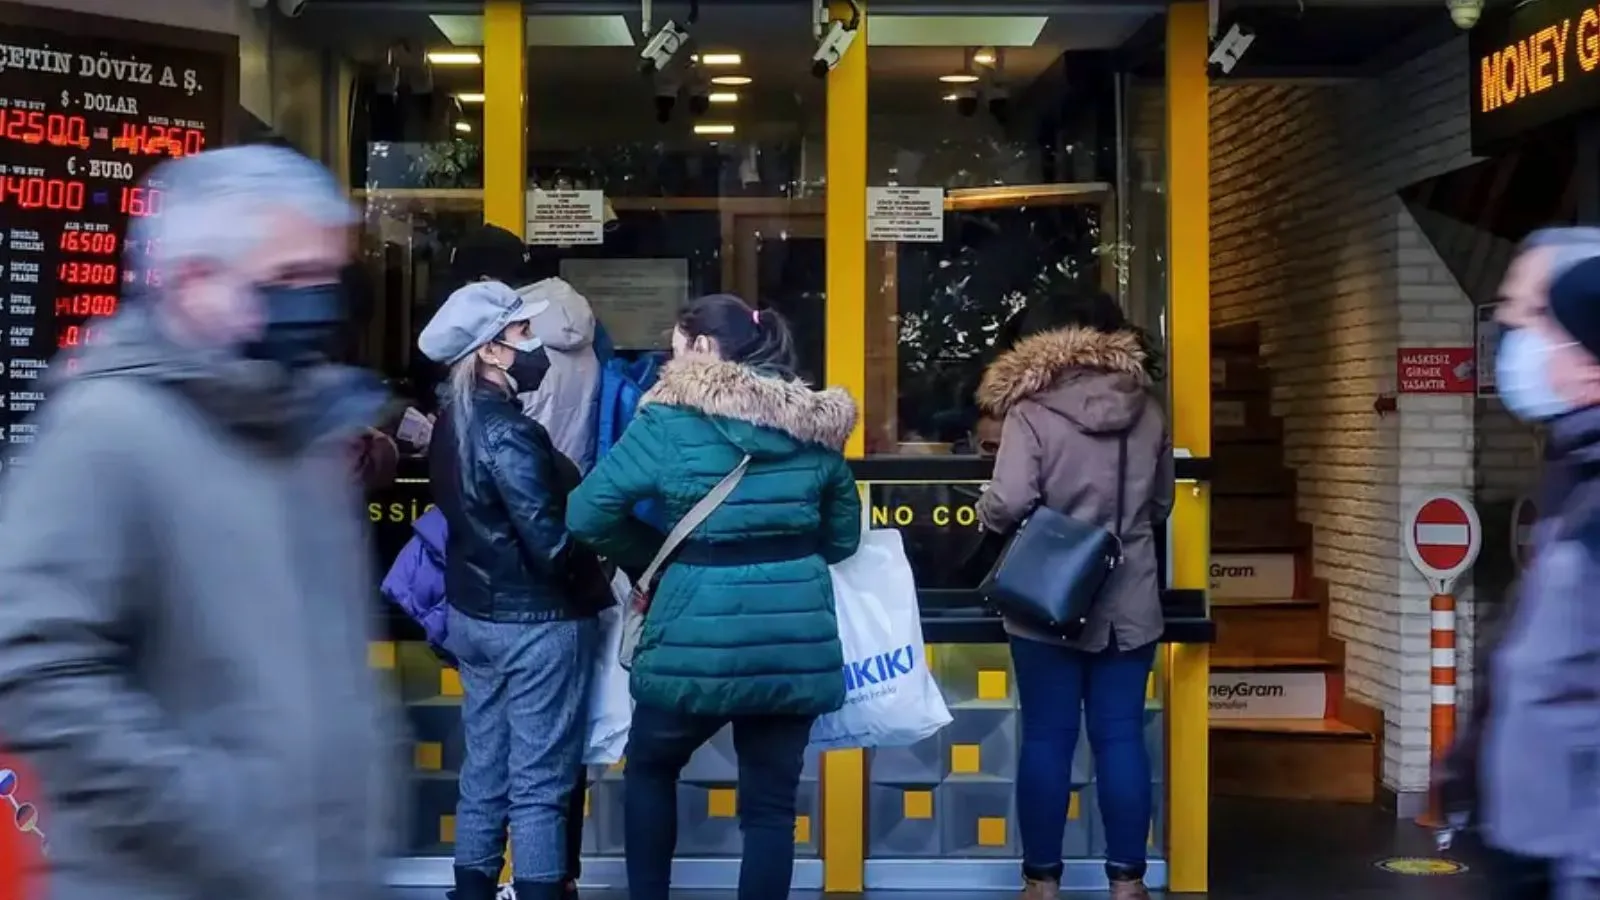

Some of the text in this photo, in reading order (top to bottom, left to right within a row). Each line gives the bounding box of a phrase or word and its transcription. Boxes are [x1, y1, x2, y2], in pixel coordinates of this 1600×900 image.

[79, 51, 153, 84] DÖVİZ
[1482, 7, 1600, 112] MONEY G
[84, 92, 139, 114] DOLAR
[89, 159, 134, 180] EURO
[872, 505, 914, 526] NO
